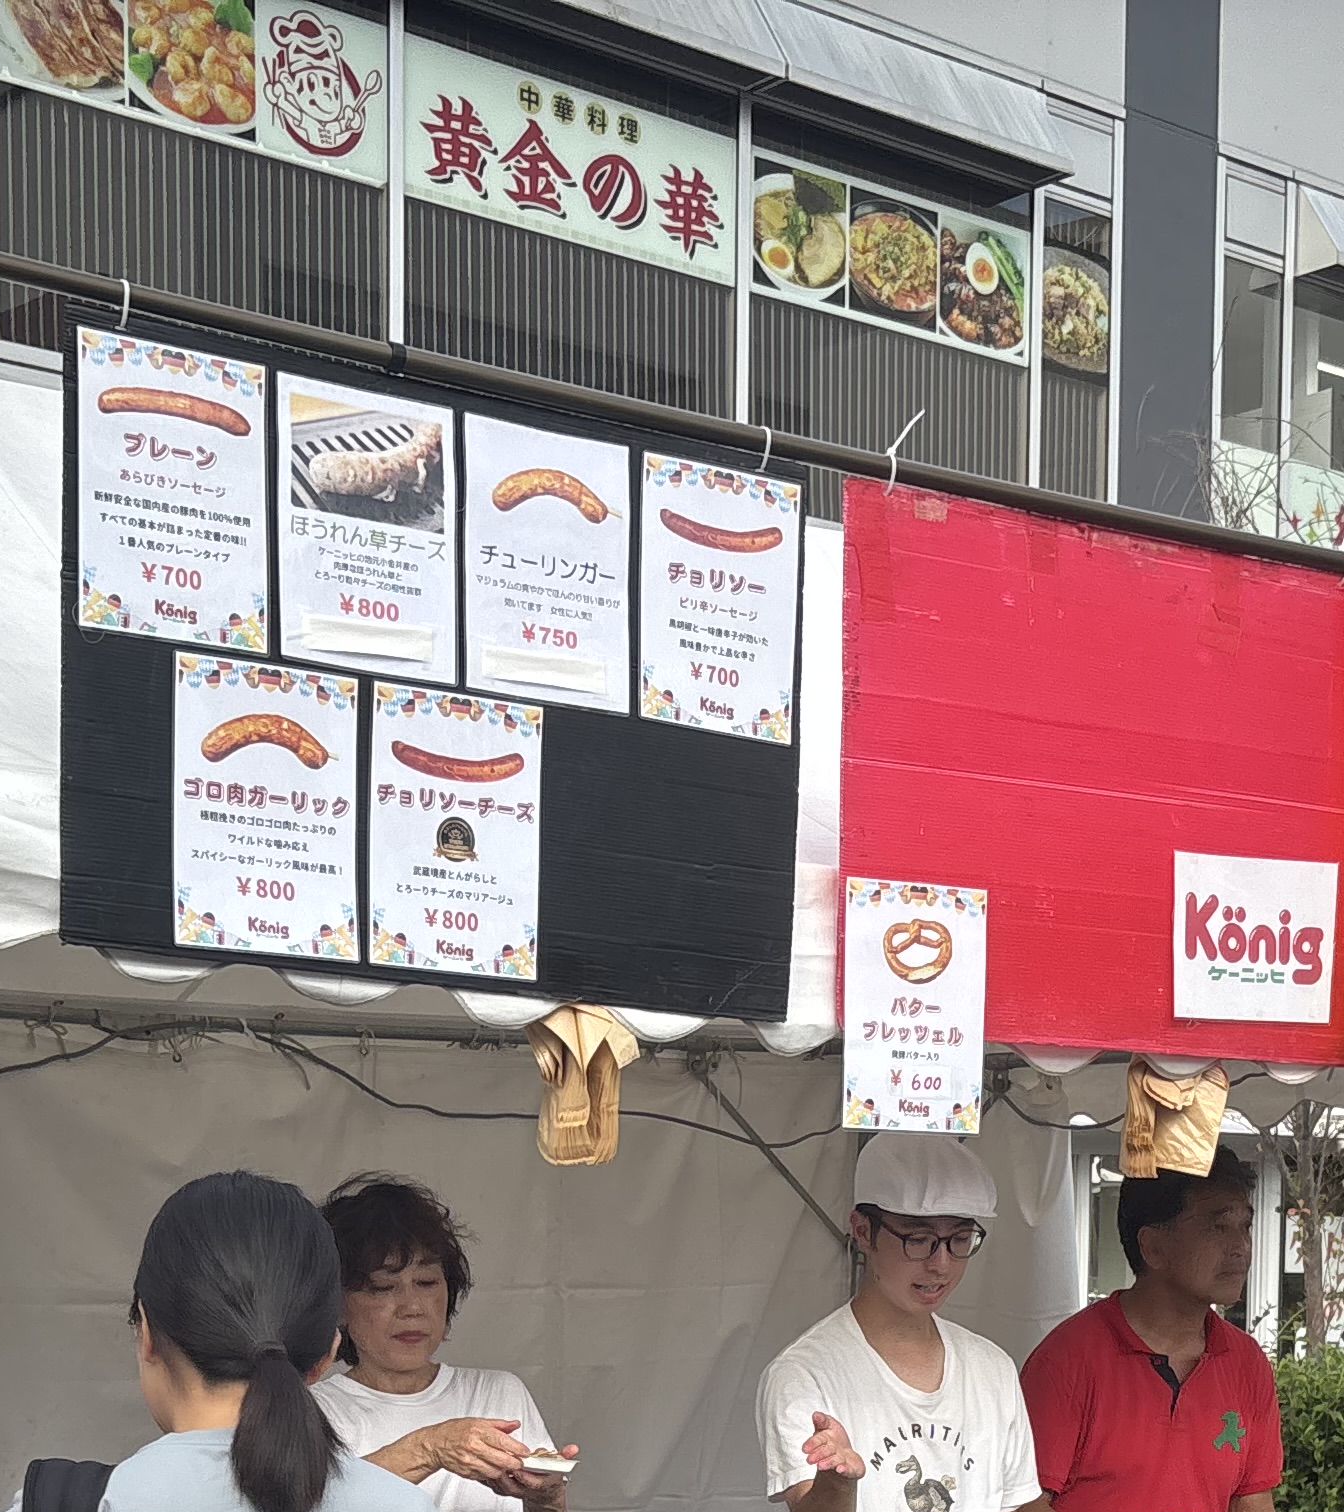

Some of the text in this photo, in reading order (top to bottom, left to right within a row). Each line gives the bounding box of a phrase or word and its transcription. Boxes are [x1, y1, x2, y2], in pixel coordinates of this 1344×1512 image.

[518, 82, 641, 144] 中華料理
[420, 94, 725, 258] 黄金の華
[124, 433, 217, 470] プレーン
[120, 469, 226, 498] あらびきソーセージ
[291, 514, 446, 561] ほうれん草チーズ
[480, 545, 615, 584] チューリンガー
[668, 562, 767, 595] チョリソー
[155, 599, 198, 625] König
[679, 596, 758, 622] ピリ辛ソーセージ
[700, 696, 734, 720] König
[183, 777, 350, 819] ゴロ肉ガーリック
[377, 783, 535, 824] チョリソーチーズ
[396, 883, 513, 905] とろーりチーズのマリアージュ
[248, 916, 290, 939] König
[1184, 891, 1324, 985] König
[436, 939, 474, 961] König
[1207, 966, 1285, 985] ケーニッヒ
[891, 997, 941, 1018] バター
[863, 1021, 963, 1047] プレッツェル
[899, 1099, 930, 1117] König
